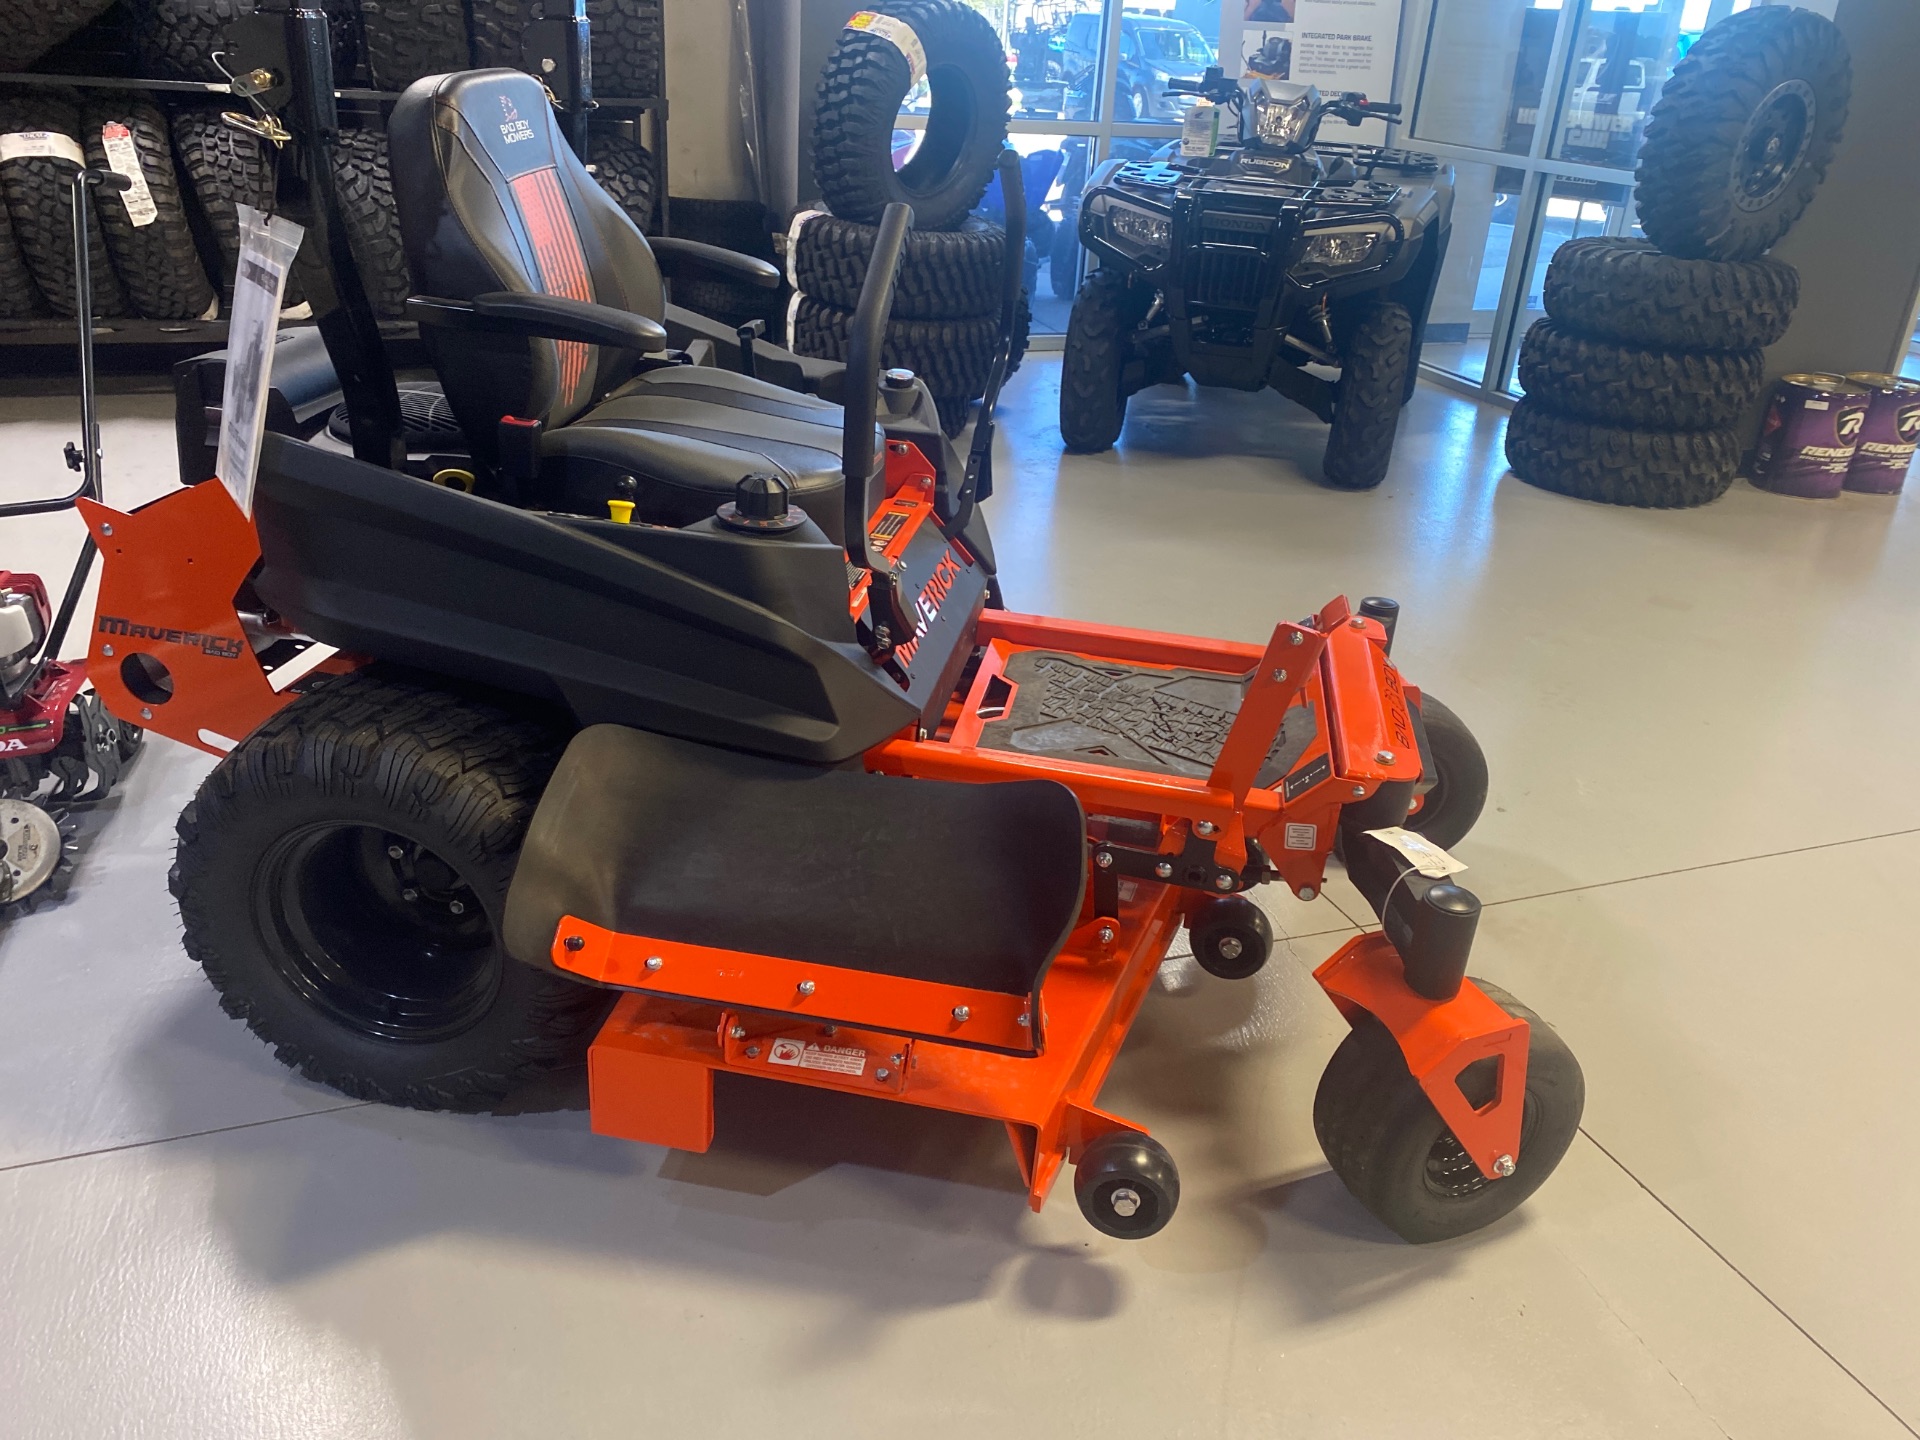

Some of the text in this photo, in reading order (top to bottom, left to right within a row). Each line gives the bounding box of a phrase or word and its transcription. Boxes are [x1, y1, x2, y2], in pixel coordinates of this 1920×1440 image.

[1302, 32, 1336, 40] INTEGRATED
[500, 120, 530, 134] BAD BOY
[504, 129, 534, 145] MOWERS
[1240, 158, 1290, 169] RUBICON
[1210, 218, 1266, 232] HONDA
[98, 615, 245, 653] MAVERICK
[1391, 708, 1410, 750] BAD
[823, 1045, 866, 1057] DANGER
